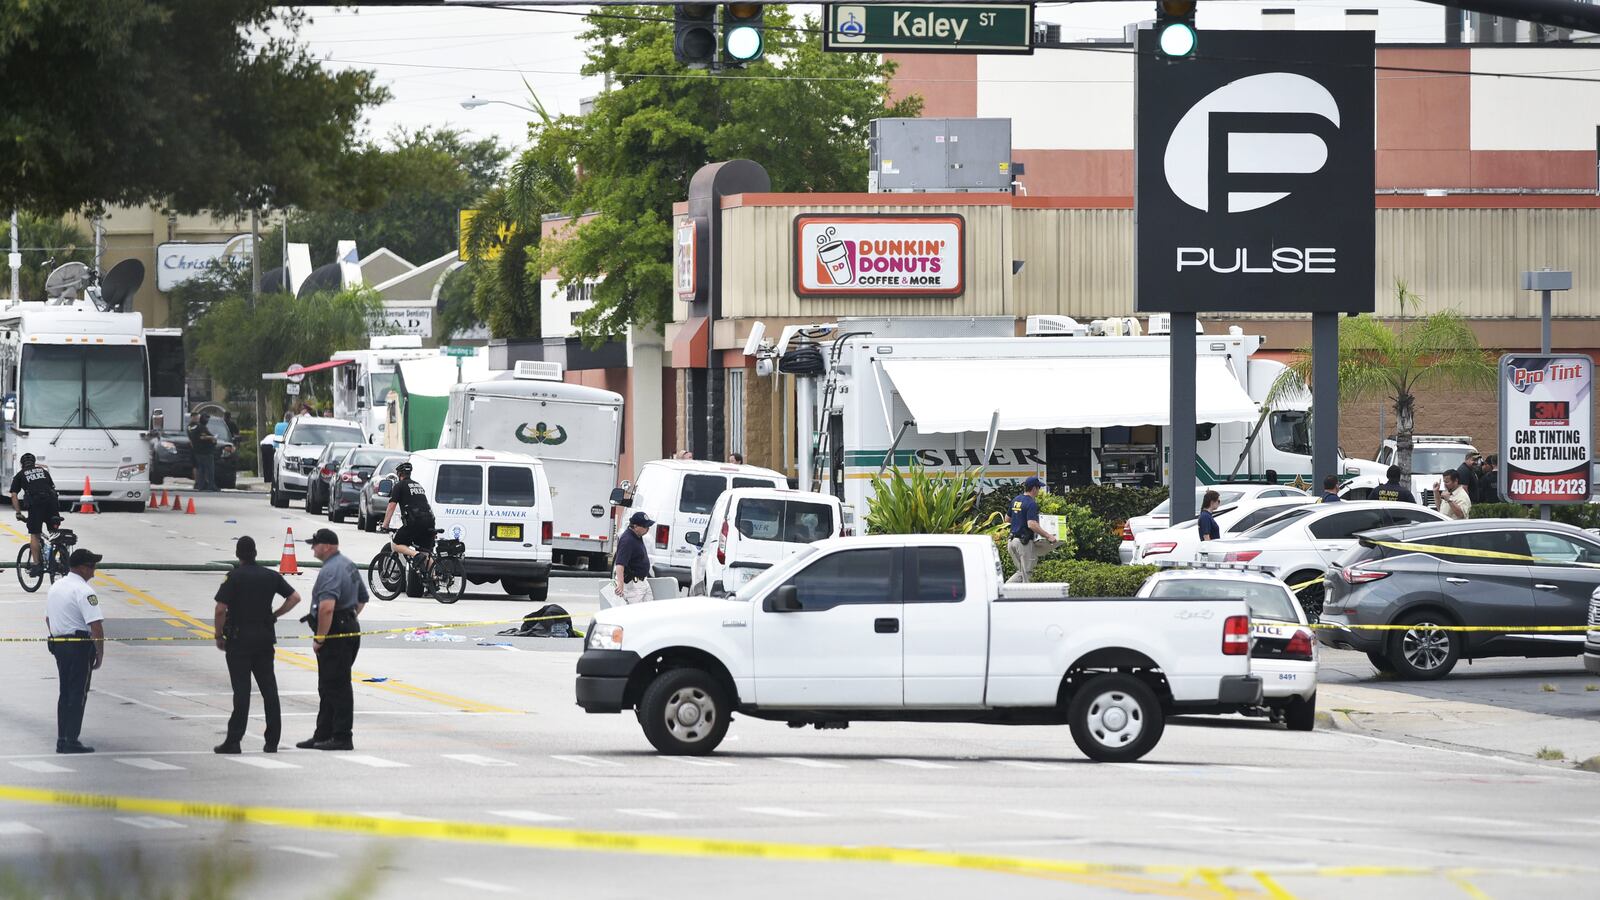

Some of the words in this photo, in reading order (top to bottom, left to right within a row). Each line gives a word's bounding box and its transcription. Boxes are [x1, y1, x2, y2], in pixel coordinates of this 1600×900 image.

[892, 11, 969, 41] Kaley
[978, 12, 997, 27] ST
[859, 240, 945, 256] DUNKIN'
[164, 254, 211, 270] Christ
[832, 262, 845, 272] DD
[859, 257, 942, 273] DONUTS
[1176, 247, 1337, 274] PULSE
[858, 276, 900, 285] COFFEE
[901, 276, 908, 284] &
[909, 276, 941, 285] MORE
[1515, 368, 1544, 385] Pro
[1550, 364, 1583, 381] Tint
[1535, 402, 1565, 418] 3M
[1515, 430, 1537, 444] CAR
[1538, 430, 1580, 444] TINTING
[916, 448, 1046, 467] SHER
[1509, 446, 1531, 461] CAR
[1533, 446, 1586, 461] DETAILING
[25, 472, 47, 483] POLICE
[1379, 490, 1399, 498] ORLANDO
[1510, 479, 1587, 495] 407.841.2123
[444, 508, 480, 516] MEDICAL
[484, 509, 527, 518] EXAMINER
[688, 517, 708, 525] MEDI
[1249, 625, 1283, 635] OLICE
[1279, 673, 1297, 681] 8491
